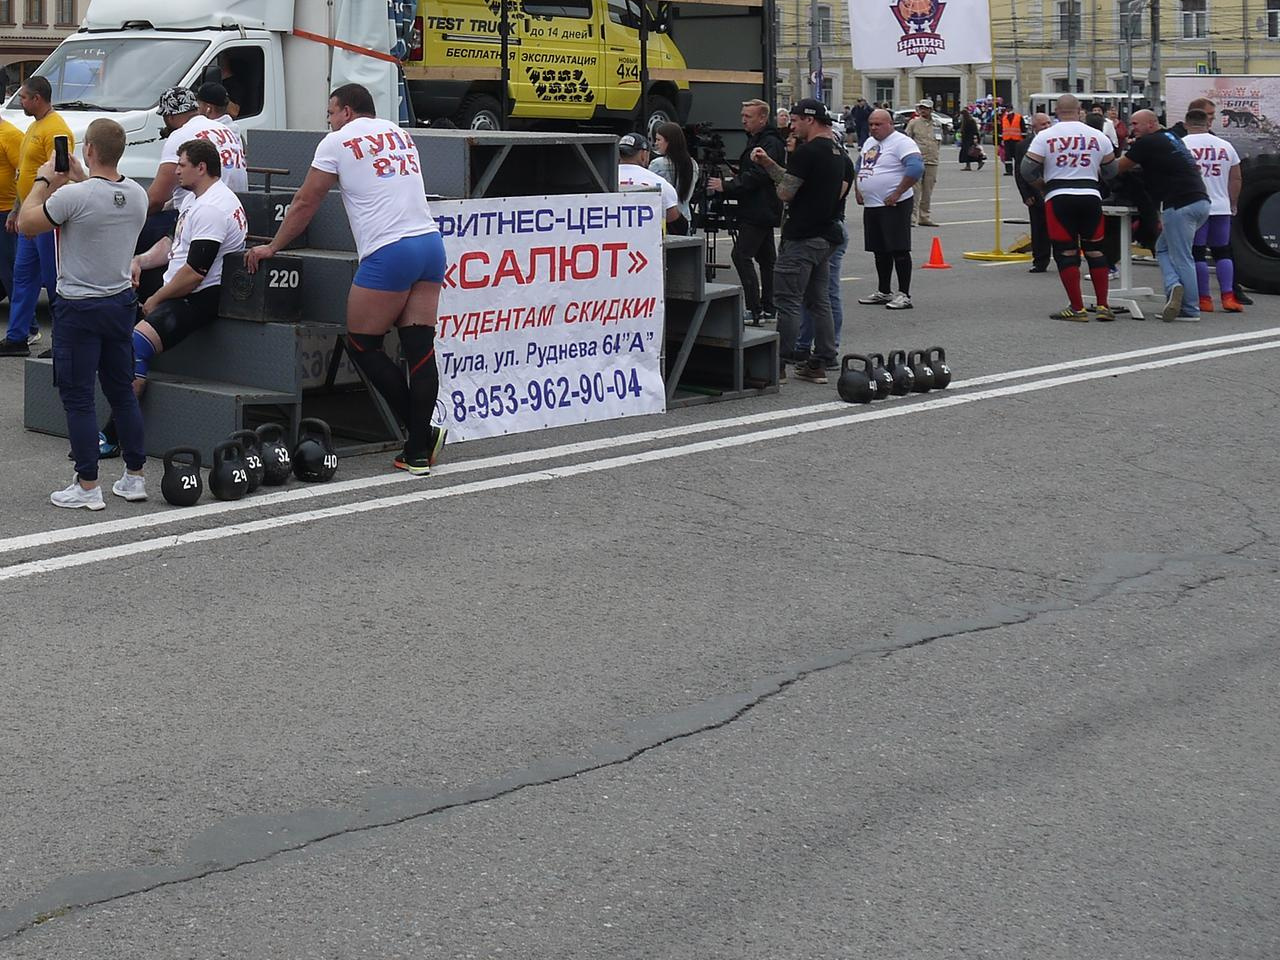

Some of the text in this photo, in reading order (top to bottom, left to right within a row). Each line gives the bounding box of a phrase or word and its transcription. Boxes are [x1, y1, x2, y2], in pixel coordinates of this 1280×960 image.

[427, 16, 517, 36] TEST TRUK
[530, 26, 588, 40] до 14 дней
[898, 37, 944, 51] НАЦИЯ
[446, 47, 597, 66] БЕСПЛАТНЯ ЭКСПЛУАТАЦИЯ
[1046, 135, 1100, 153] ТУЛА
[372, 153, 420, 179] 875
[1055, 153, 1091, 168] 875
[433, 205, 654, 238] ФИТНЕС-ЦЕНТР
[268, 269, 299, 289] 220
[564, 297, 657, 326] СКИДКИ!
[442, 351, 488, 379] Тула,
[494, 349, 519, 375] ул.
[526, 340, 597, 368] Руднева
[451, 367, 642, 423] 8-953-962-90-04
[246, 455, 262, 470] 32
[274, 447, 291, 463] 32
[323, 454, 338, 469] 40
[181, 474, 198, 490] 24
[232, 468, 248, 483] 24
